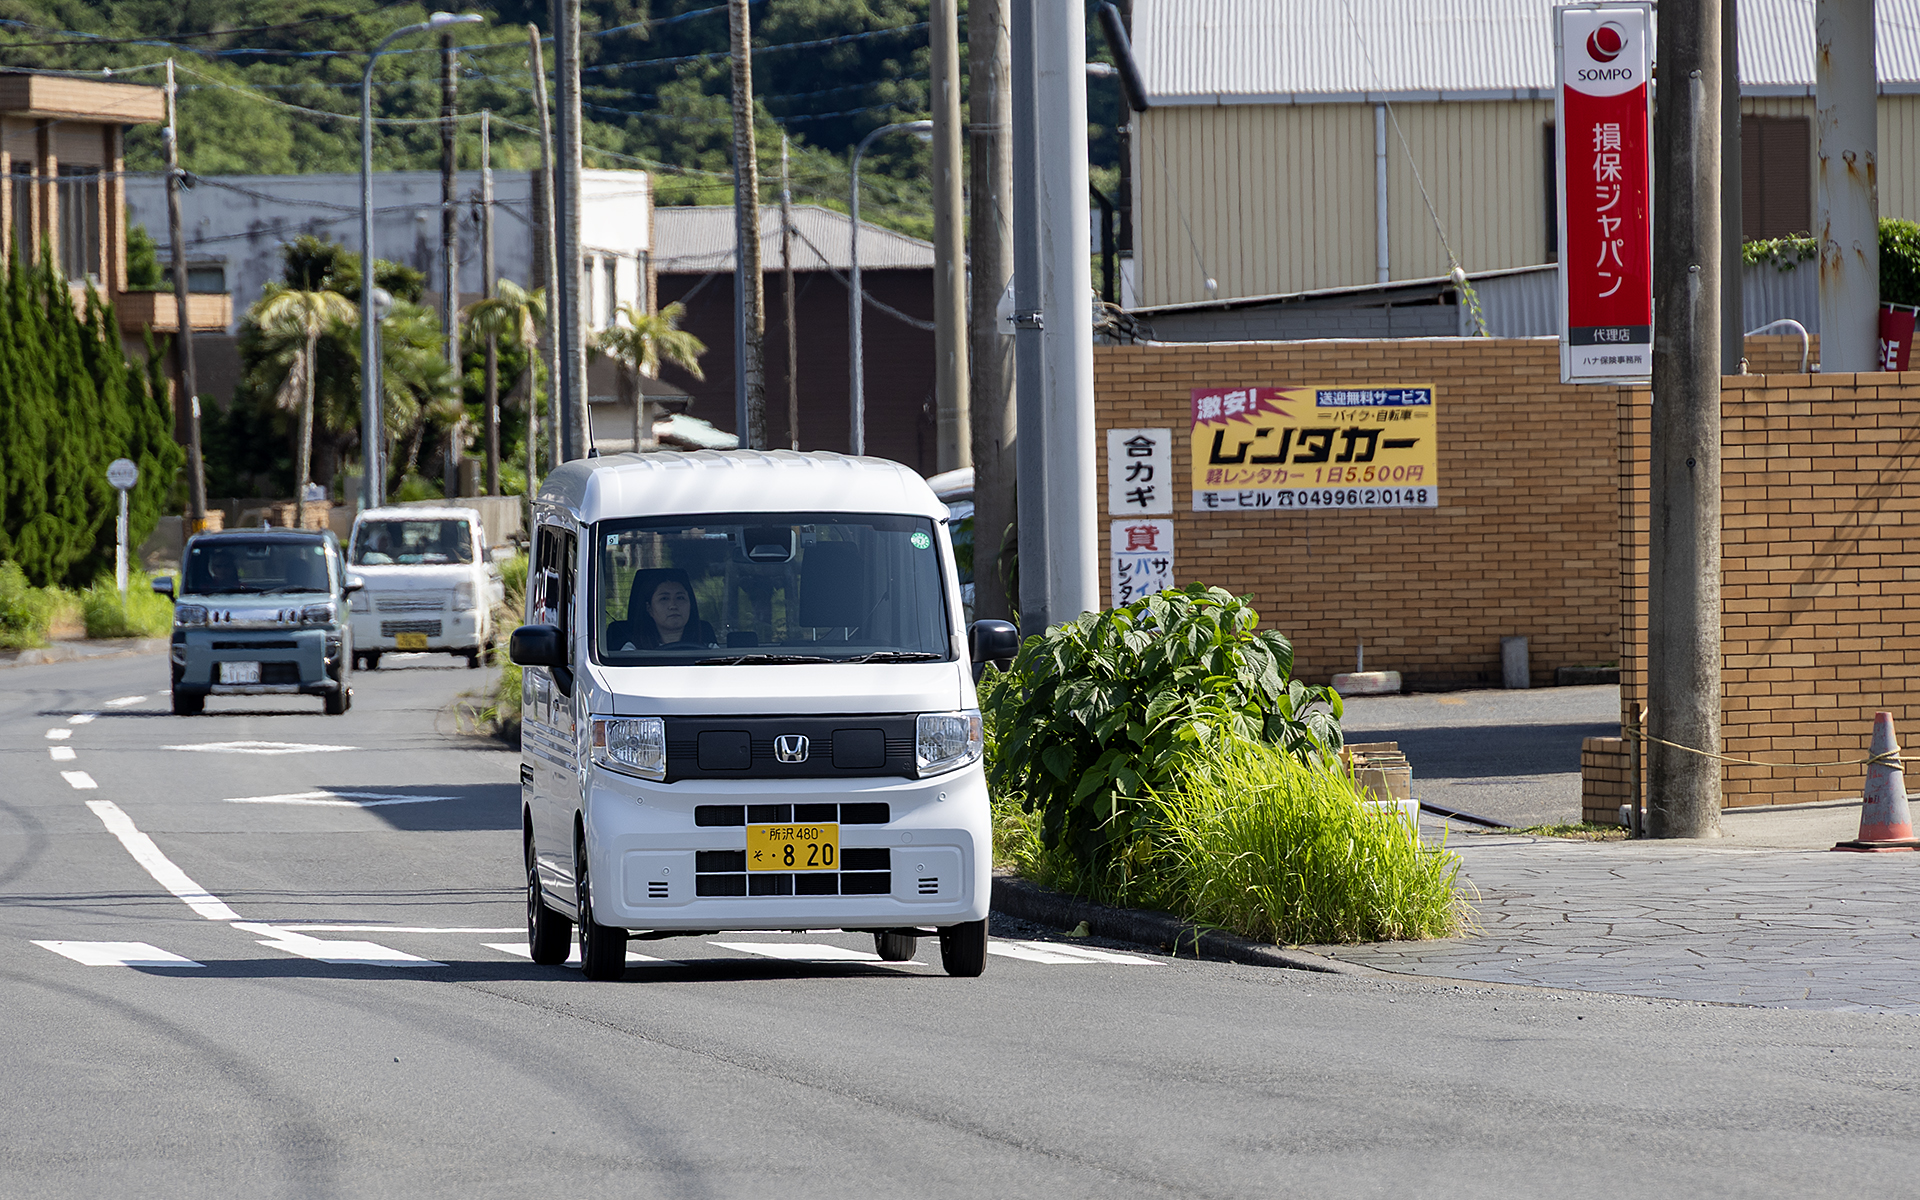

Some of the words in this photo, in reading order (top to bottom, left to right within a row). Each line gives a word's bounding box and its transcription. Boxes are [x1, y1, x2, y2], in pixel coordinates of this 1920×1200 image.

[1578, 68, 1632, 81] SOMPO
[1592, 122, 1624, 298] 損保ジャパン
[1593, 328, 1630, 342] 代理店
[1583, 355, 1642, 365] ハナ保険事務所
[1319, 390, 1429, 405] 送迎無料サービス
[1209, 426, 1420, 465] レンタカー
[1123, 434, 1156, 507] 合カギ
[1205, 468, 1305, 485] 軽レンタカー
[1202, 490, 1272, 508] モービル
[1298, 489, 1428, 506] 04996(2)0148
[1124, 525, 1160, 551] 貸
